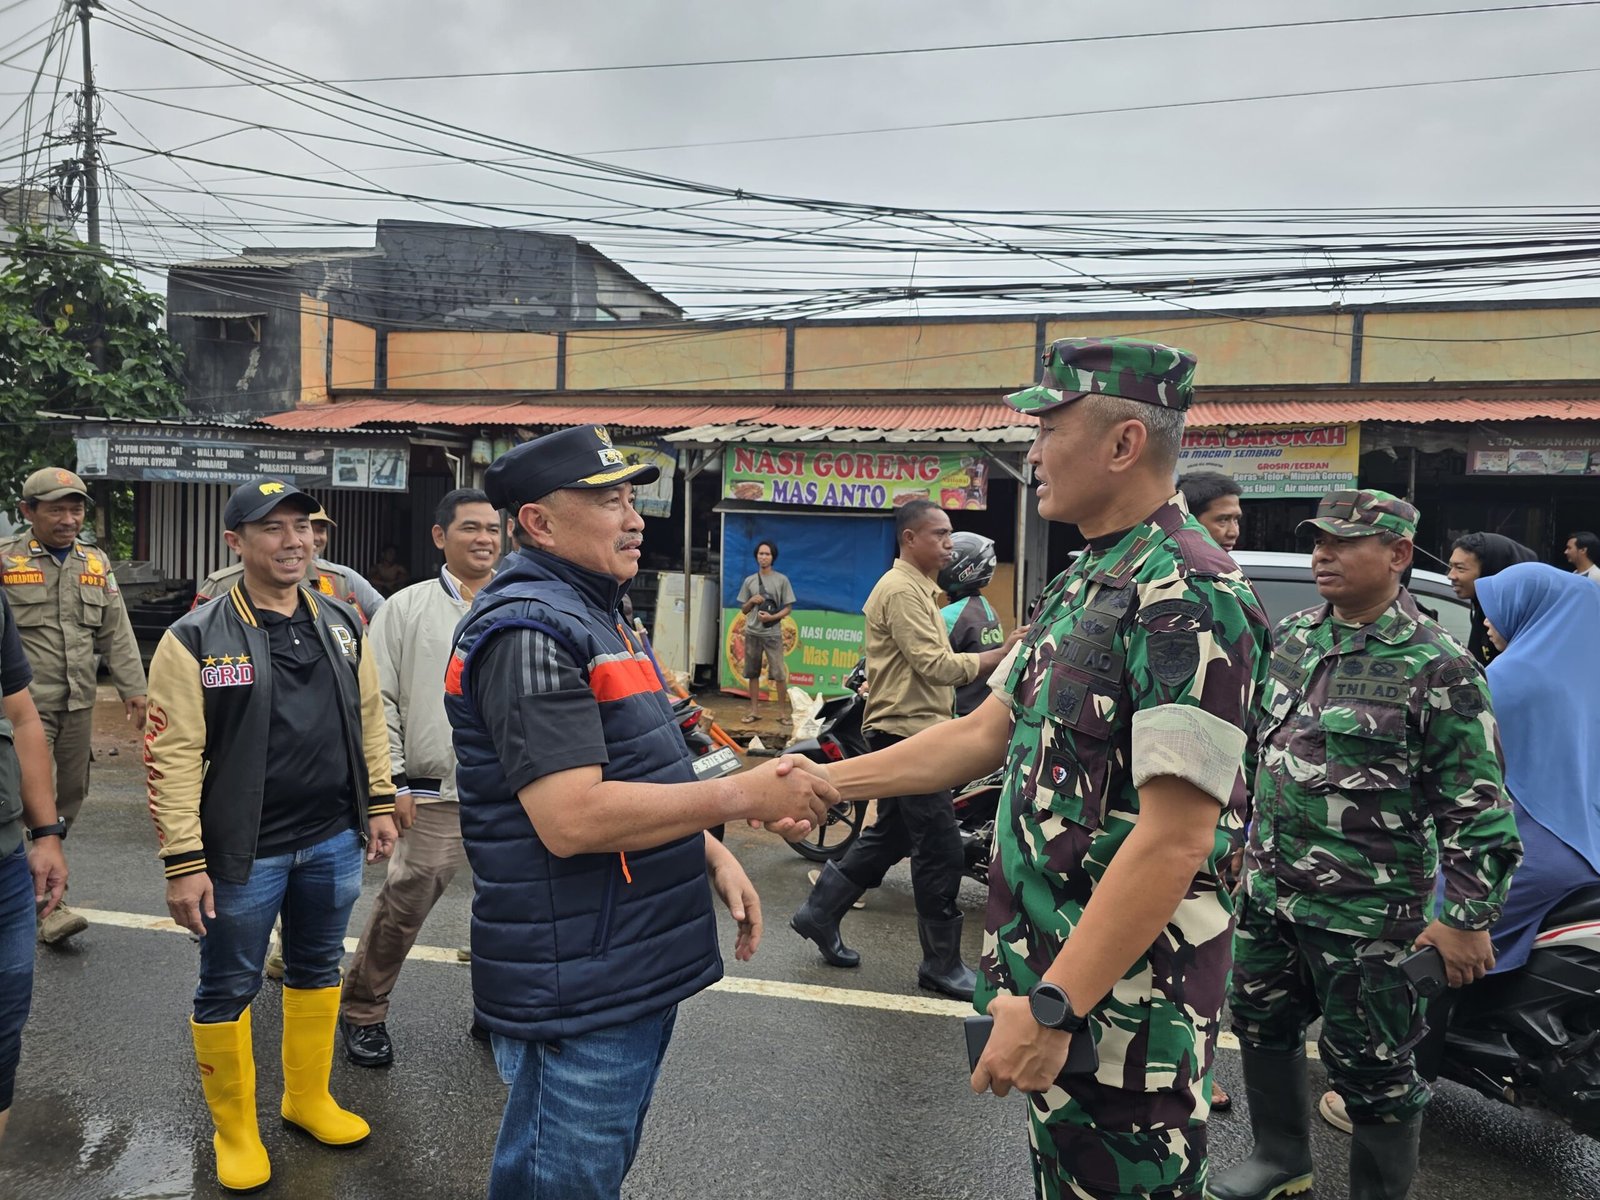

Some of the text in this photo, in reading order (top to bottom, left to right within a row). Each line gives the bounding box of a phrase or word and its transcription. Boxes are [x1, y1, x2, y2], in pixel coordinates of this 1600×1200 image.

[1223, 425, 1347, 448] BAROKAH
[114, 444, 184, 456] PLAFON GYPSUM CAT
[196, 448, 245, 459] WALL MOLDING
[259, 450, 297, 460] BATU NISAN
[1191, 450, 1232, 459] MACAM
[1233, 448, 1283, 458] SEMBAKO
[115, 456, 177, 468] LIST PROFIL GYPSUM
[196, 460, 228, 470] ORNAMEN
[734, 448, 941, 482] NASI GORENG
[1257, 462, 1330, 471] GROSIR/ECERAN
[259, 462, 328, 476] PRASASTI PERESMIAN
[1233, 472, 1258, 482] Beras
[1290, 472, 1320, 482] Minyak
[1322, 472, 1353, 482] Goreng
[772, 479, 886, 508] MAS ANTO
[1254, 484, 1276, 494] Elpiji
[1284, 484, 1297, 492] Air
[800, 626, 864, 643] NASI GORENG
[803, 646, 828, 667] Mas
[1060, 638, 1113, 674] TNI AD
[1336, 684, 1400, 698] TNI AD
